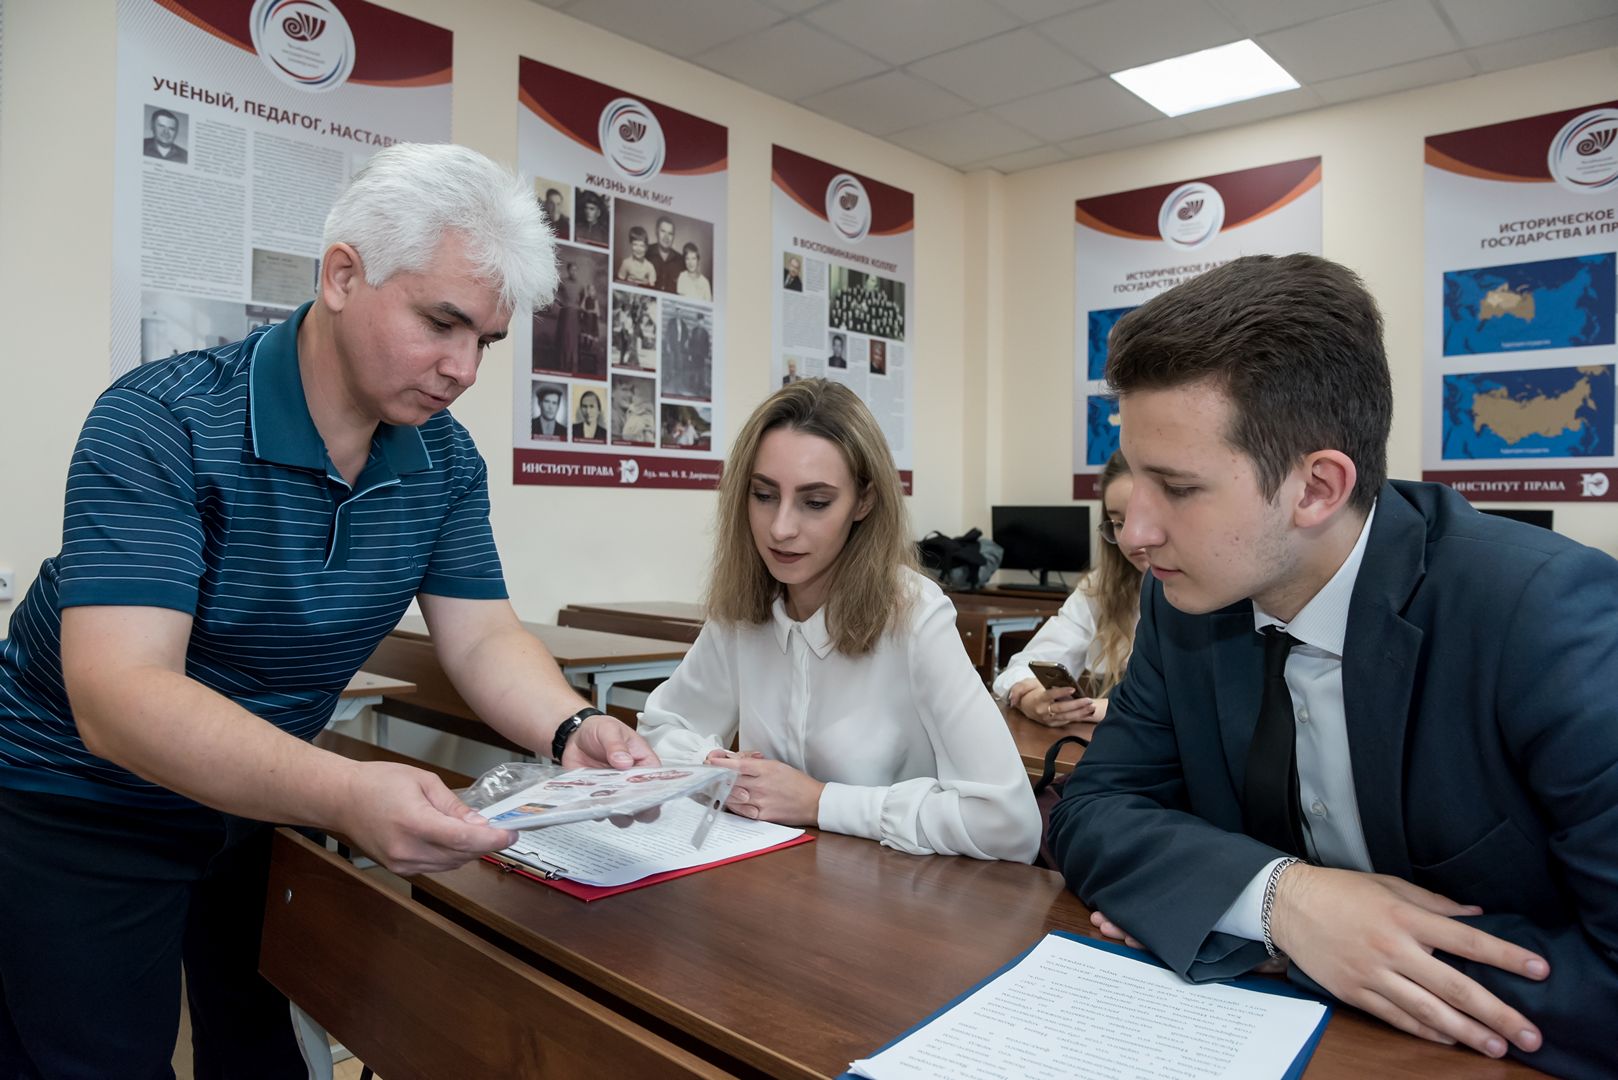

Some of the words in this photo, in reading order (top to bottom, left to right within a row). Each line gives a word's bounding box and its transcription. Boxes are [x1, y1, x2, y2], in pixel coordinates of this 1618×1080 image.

[152, 76, 239, 113] УЧЁНЫЙ,
[244, 100, 326, 135] ПЕДАГОГ,
[330, 122, 402, 148] НАСТАВ
[585, 173, 626, 194] ЖИЗНЬ
[628, 184, 650, 201] КАК
[651, 191, 675, 206] МИГ
[1499, 209, 1615, 233] ИСТОРИЧЕСКОЕ
[1480, 227, 1583, 249] ГОСУДАРСТВА
[1585, 224, 1596, 236] И
[522, 462, 581, 477] ИНСТИТУТ
[583, 465, 615, 477] ПРАВА
[1524, 480, 1566, 491] ПРАВА
